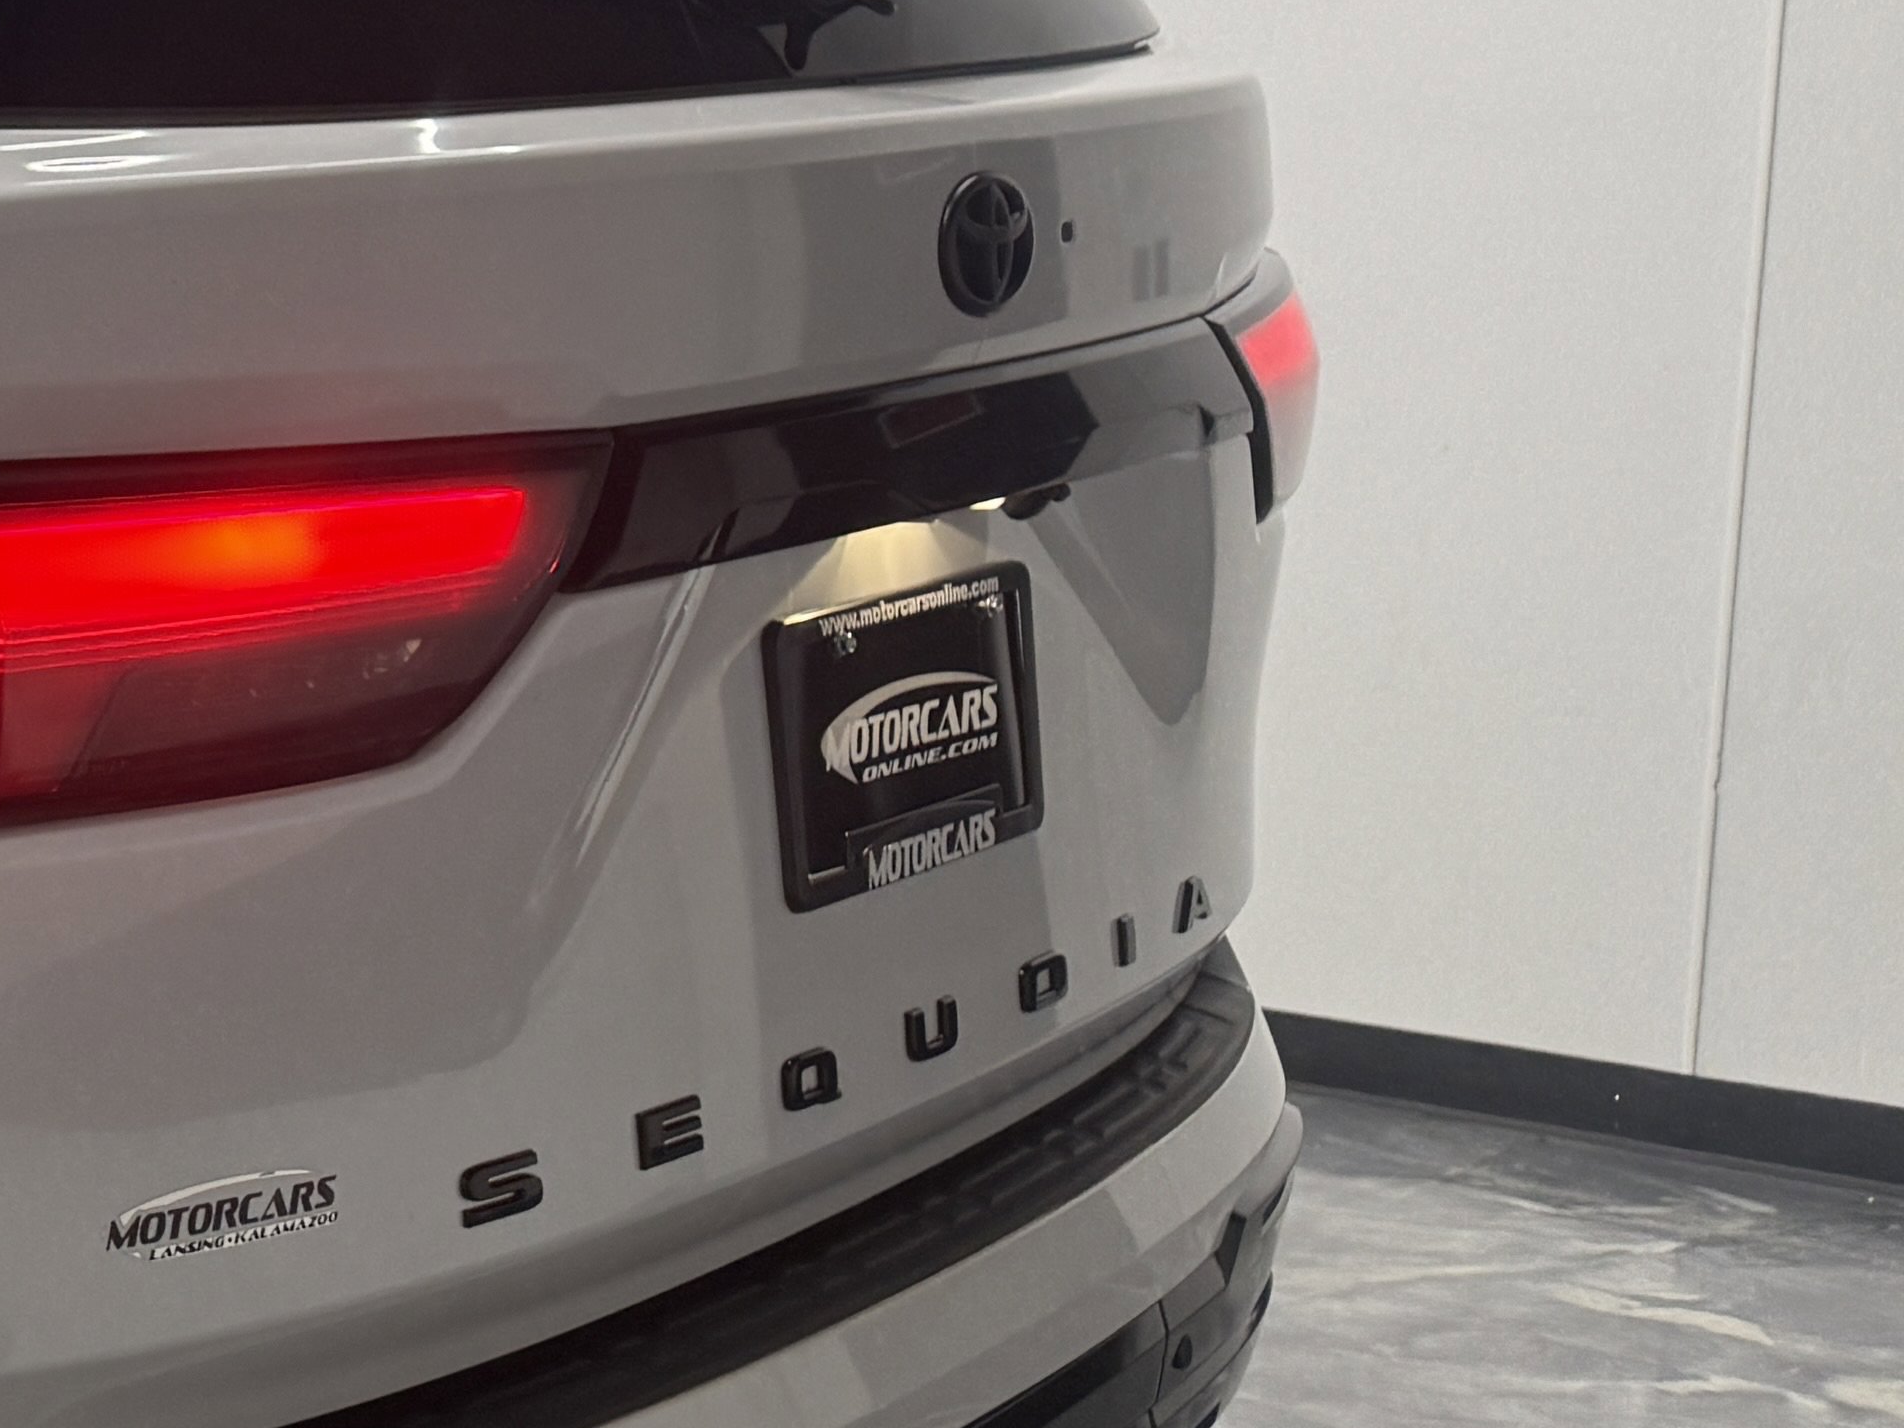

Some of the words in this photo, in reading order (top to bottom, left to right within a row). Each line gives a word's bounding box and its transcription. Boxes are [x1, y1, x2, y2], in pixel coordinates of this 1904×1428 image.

[818, 575, 1000, 636] www.motorcarsonline.com
[825, 683, 998, 772] MOTORCARS
[861, 731, 998, 783] ONLINE.COM
[867, 807, 996, 890] MOTORCARS
[459, 875, 1211, 1228] SEQUOIA
[105, 1174, 337, 1252] MOTORCARS
